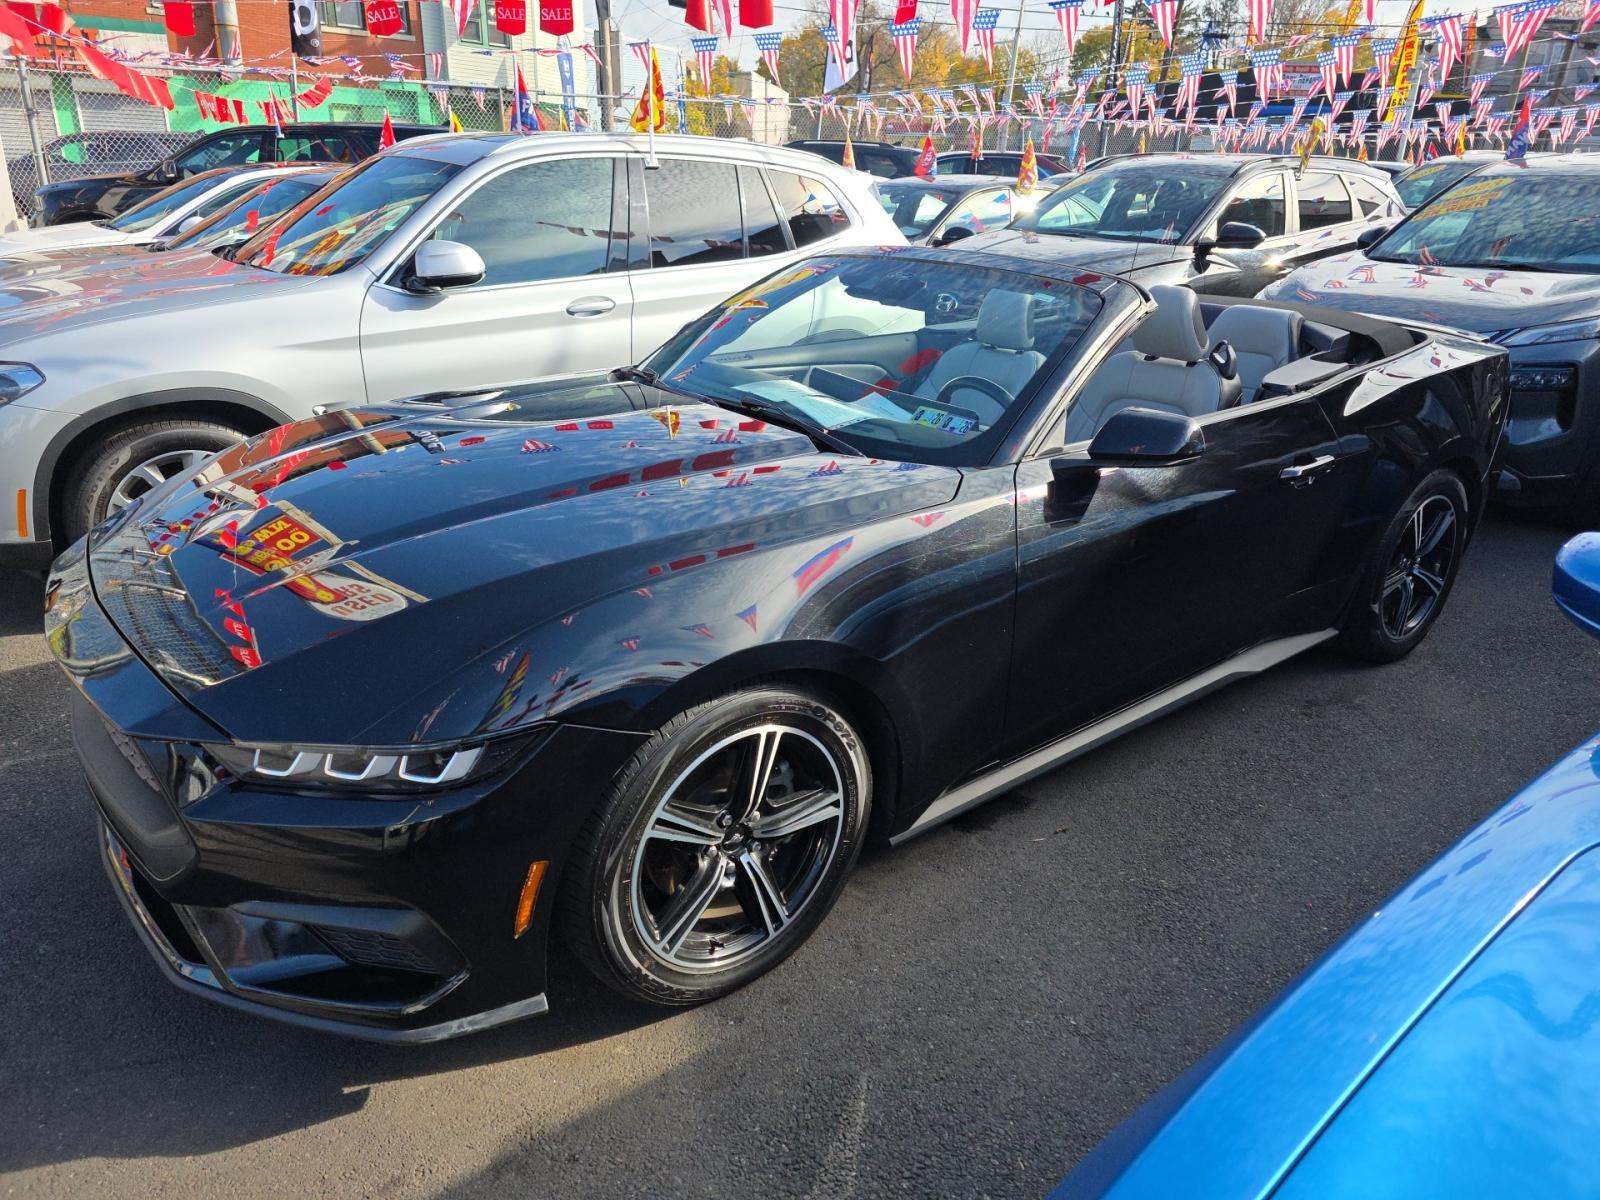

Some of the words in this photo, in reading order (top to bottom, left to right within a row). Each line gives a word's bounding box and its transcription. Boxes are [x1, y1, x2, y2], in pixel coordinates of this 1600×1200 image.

[367, 7, 398, 24] SALE
[498, 7, 525, 20] SALE
[541, 8, 572, 21] SALE
